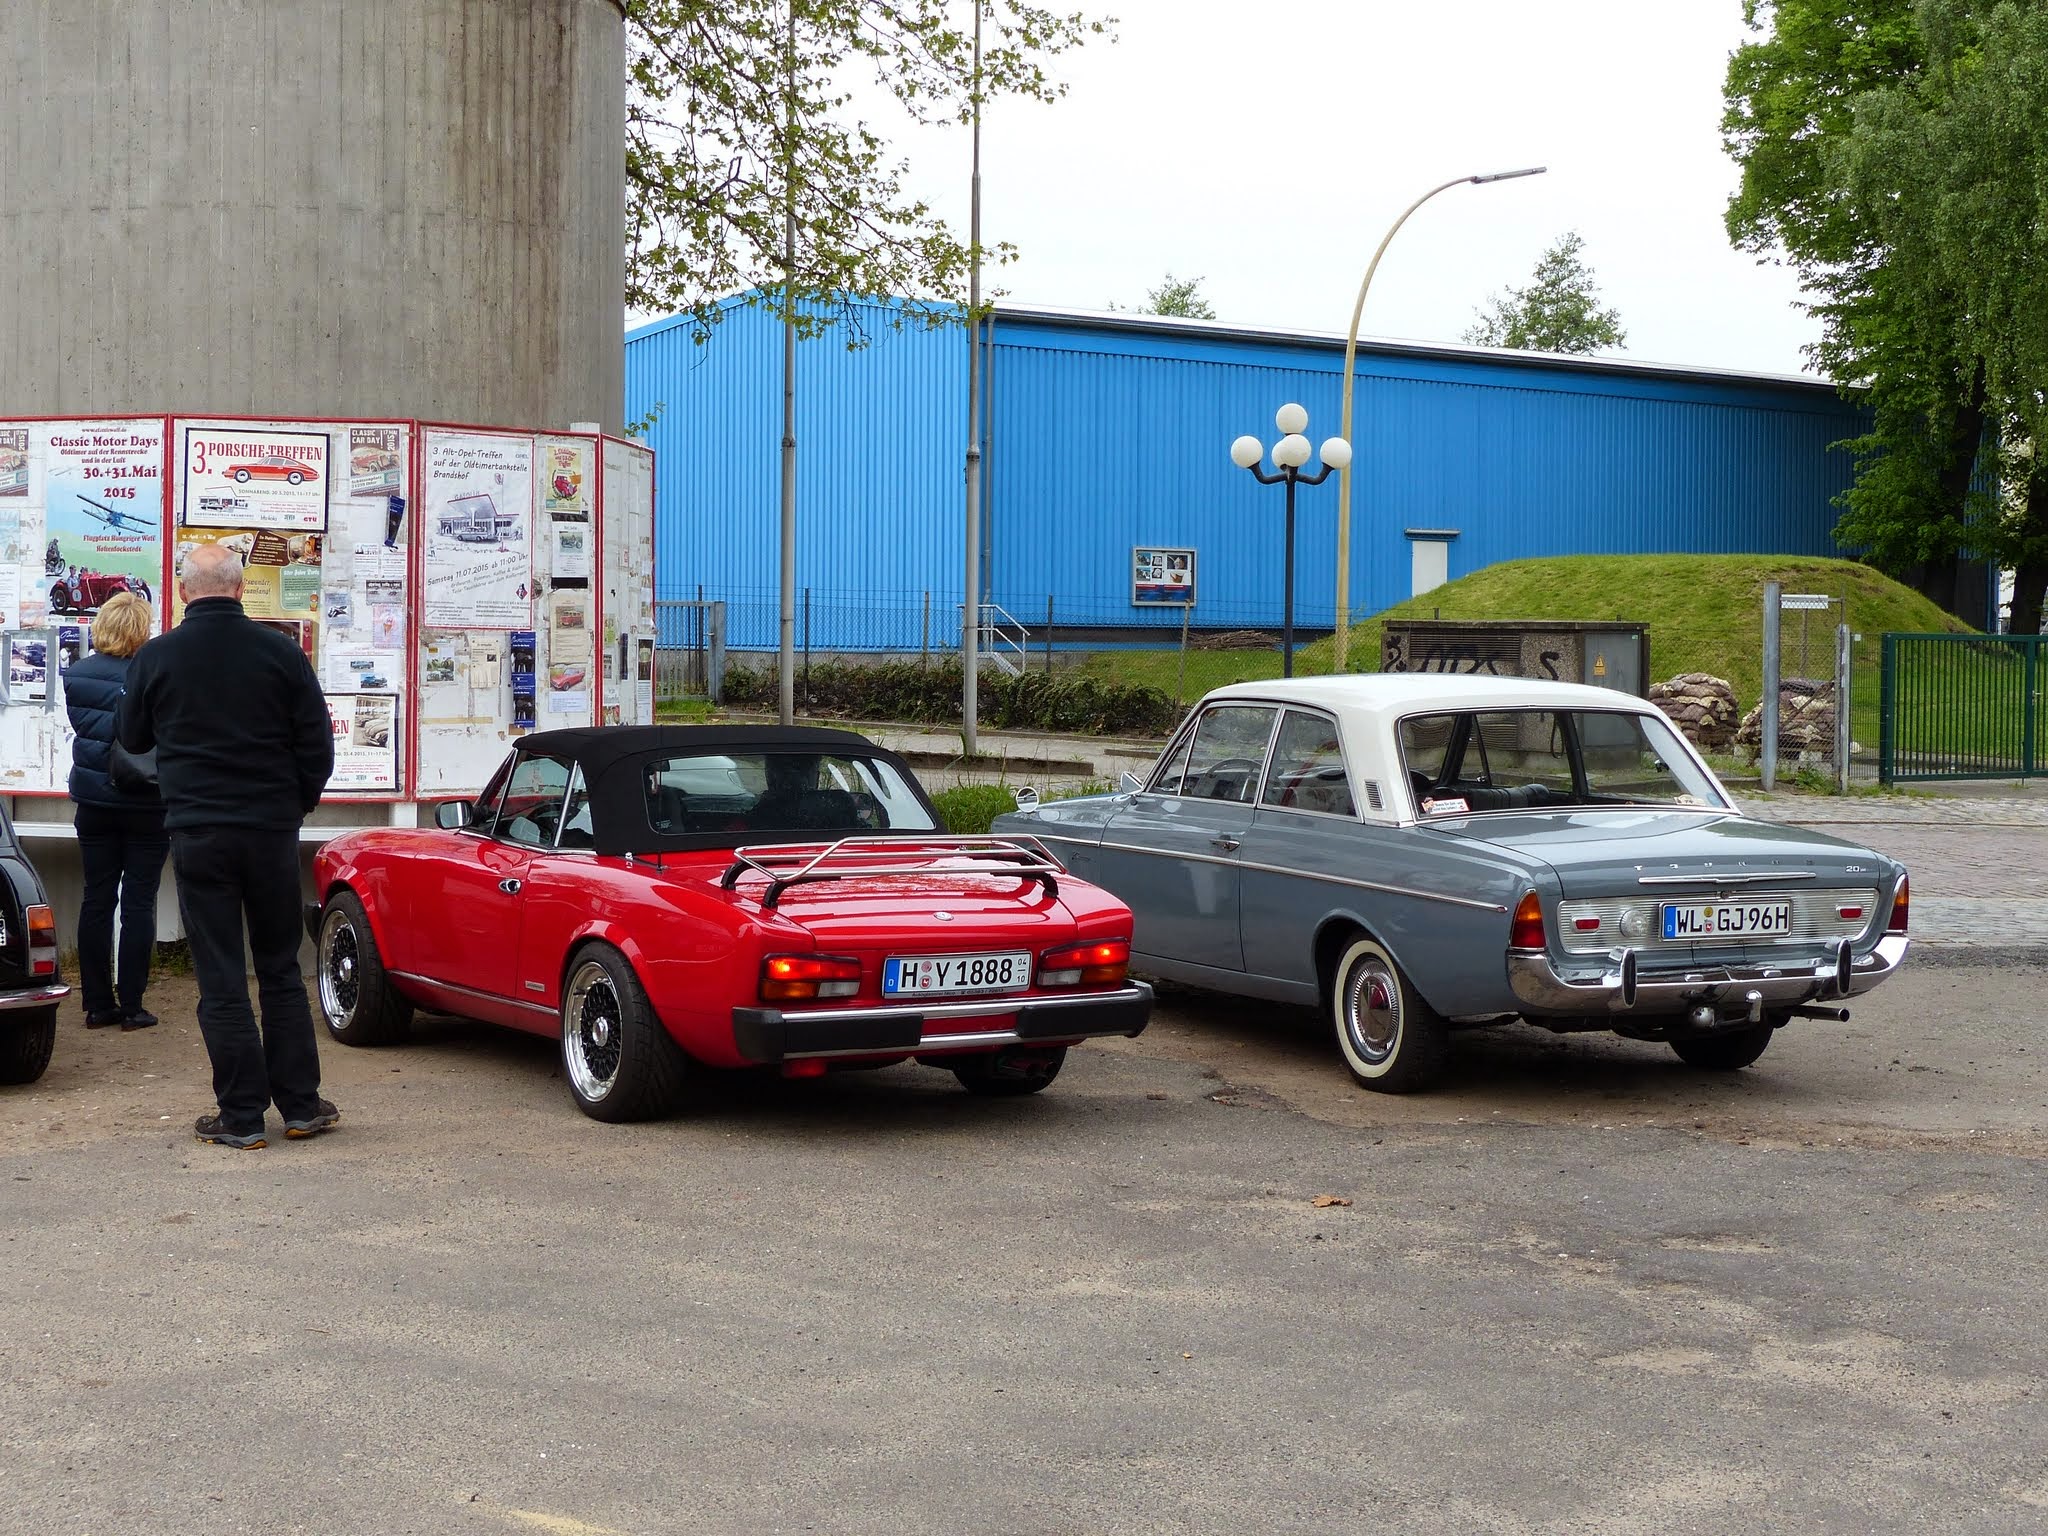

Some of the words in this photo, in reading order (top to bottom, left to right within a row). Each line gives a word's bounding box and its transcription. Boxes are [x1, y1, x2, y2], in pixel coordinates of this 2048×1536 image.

[50, 436, 89, 446] Classic
[92, 436, 127, 446] Motor
[130, 436, 158, 448] Days
[192, 441, 212, 474] 3.
[208, 442, 322, 461] PORSCHE-TREFFEN
[443, 448, 503, 459] Alt-Opel-Treffen
[83, 466, 157, 479] 30.+31.Mai
[464, 461, 527, 472] Oldtimertankstelle
[434, 472, 470, 480] Brandshof
[104, 488, 135, 499] 2015
[83, 535, 110, 543] Flugplatz
[428, 574, 454, 586] Samstag
[492, 561, 498, 569] ab
[500, 556, 516, 566] 11:00
[518, 552, 528, 561] Uhr
[1677, 909, 1702, 933] WL
[1717, 908, 1743, 931] GJ
[1750, 906, 1788, 929] 96H
[901, 963, 918, 987] H
[936, 962, 950, 986] Y
[955, 959, 1012, 986] 1888
